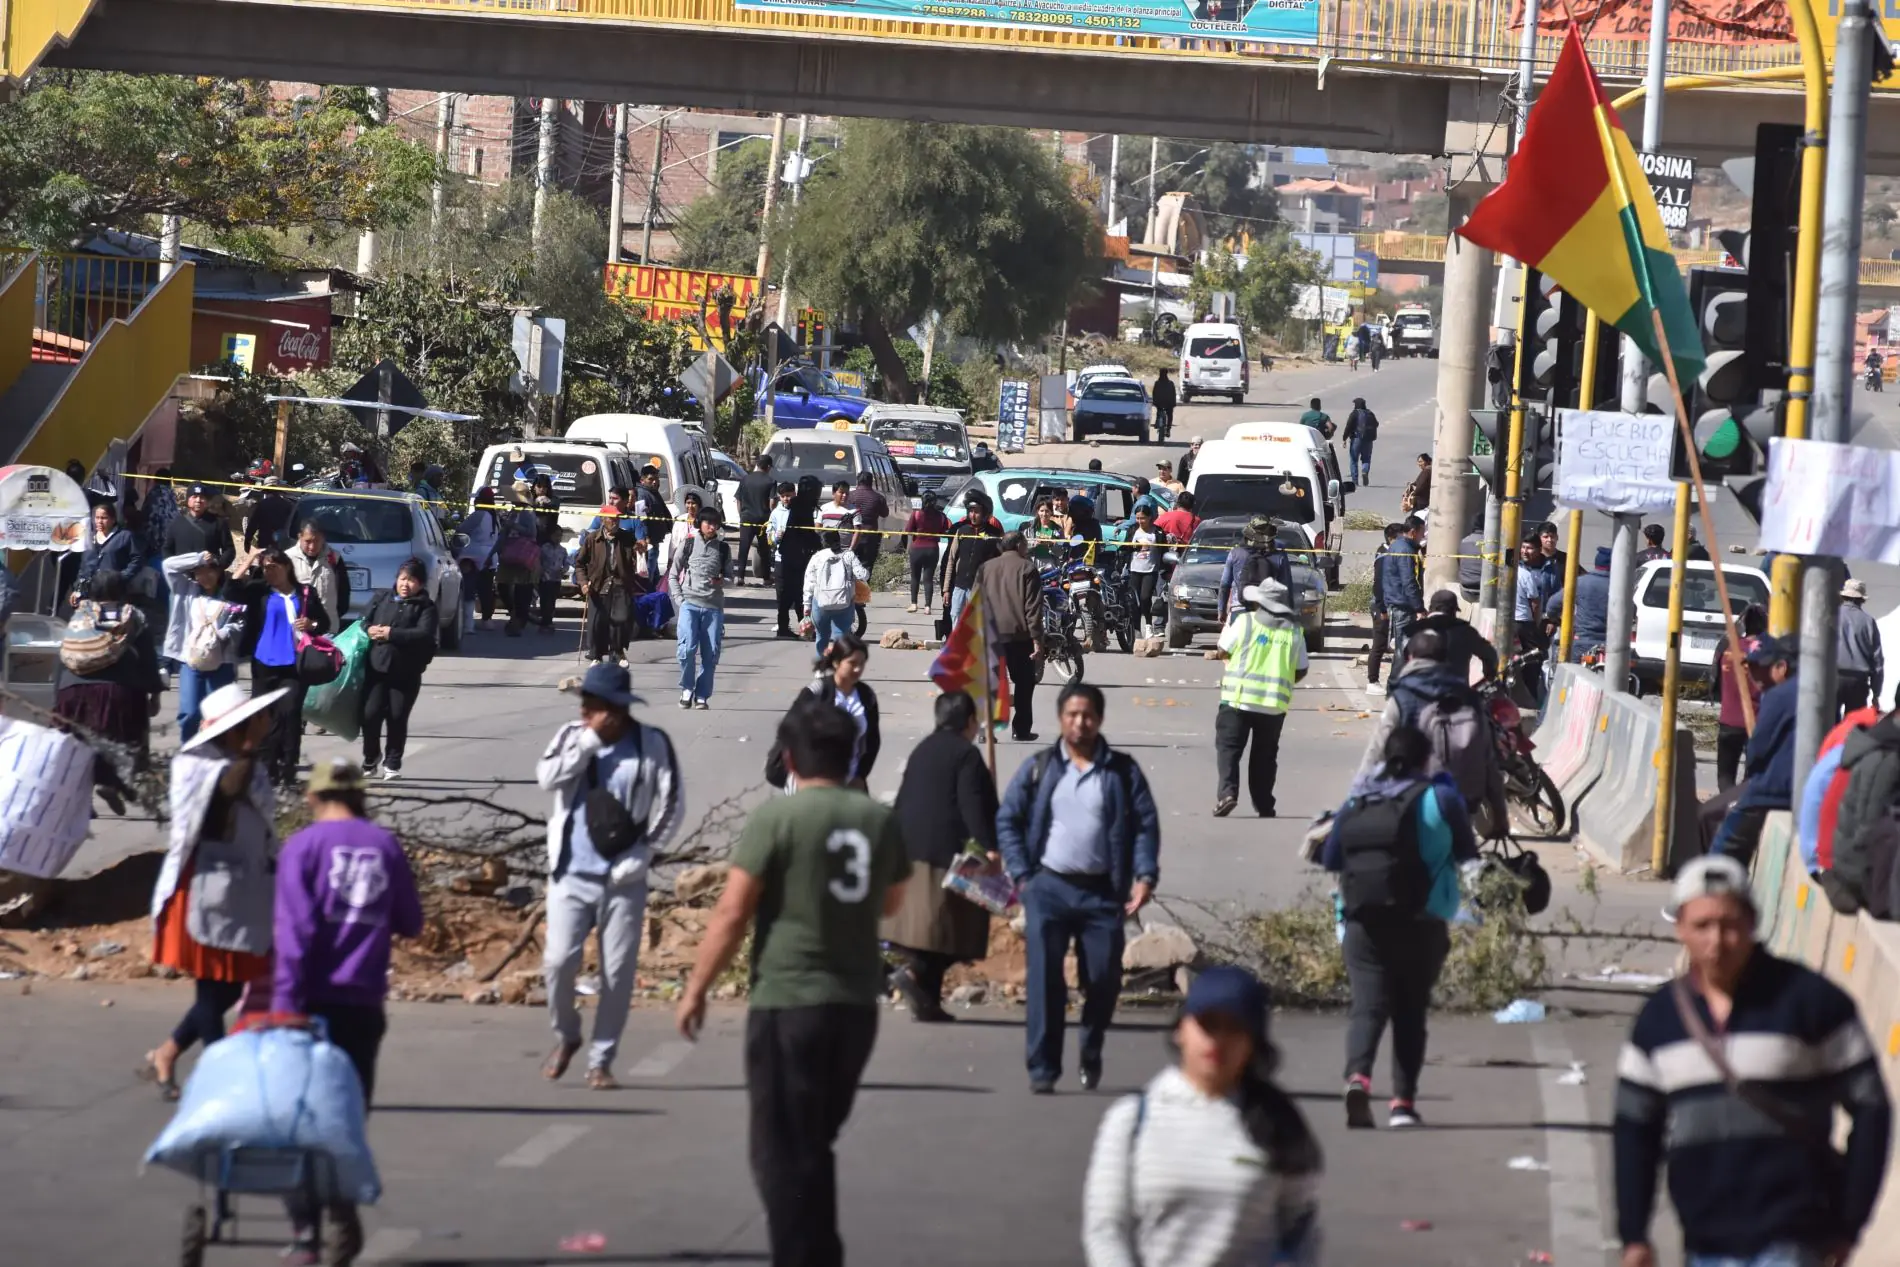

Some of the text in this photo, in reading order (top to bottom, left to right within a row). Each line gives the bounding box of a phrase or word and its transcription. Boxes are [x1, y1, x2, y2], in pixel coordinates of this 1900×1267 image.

[1269, 1, 1304, 9] DIGITAL
[1010, 11, 1073, 24] 78328095
[1085, 16, 1140, 28] 4501132
[1190, 22, 1247, 32] COCTELERIA
[1011, 381, 1028, 448] REPUESTOS
[1578, 440, 1670, 460] ESCUCHA
[1622, 485, 1676, 507] LUCH
[827, 829, 871, 903] 3
